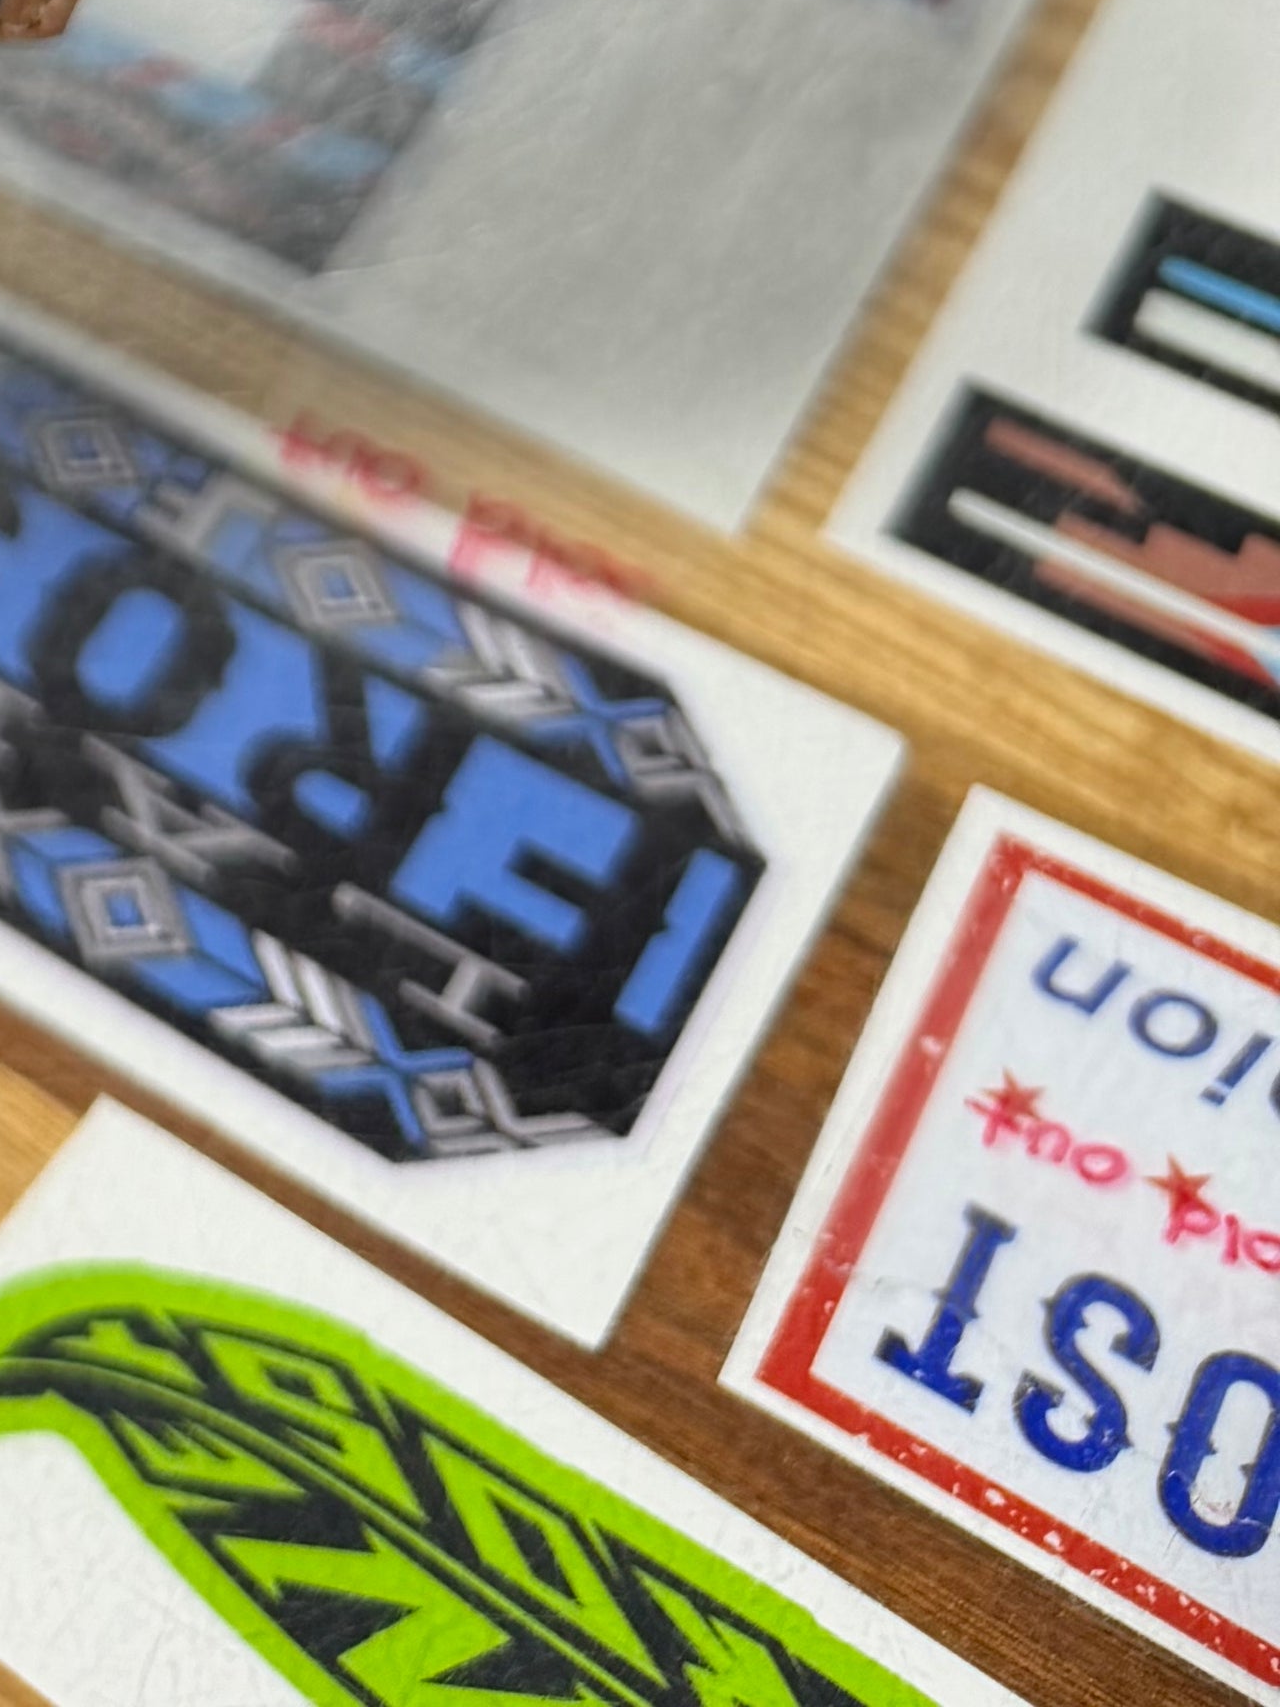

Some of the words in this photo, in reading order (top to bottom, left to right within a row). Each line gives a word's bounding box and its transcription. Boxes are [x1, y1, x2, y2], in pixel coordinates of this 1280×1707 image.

[267, 407, 431, 504] out
[1032, 936, 1280, 1117] ion
[966, 1093, 1132, 1185] out
